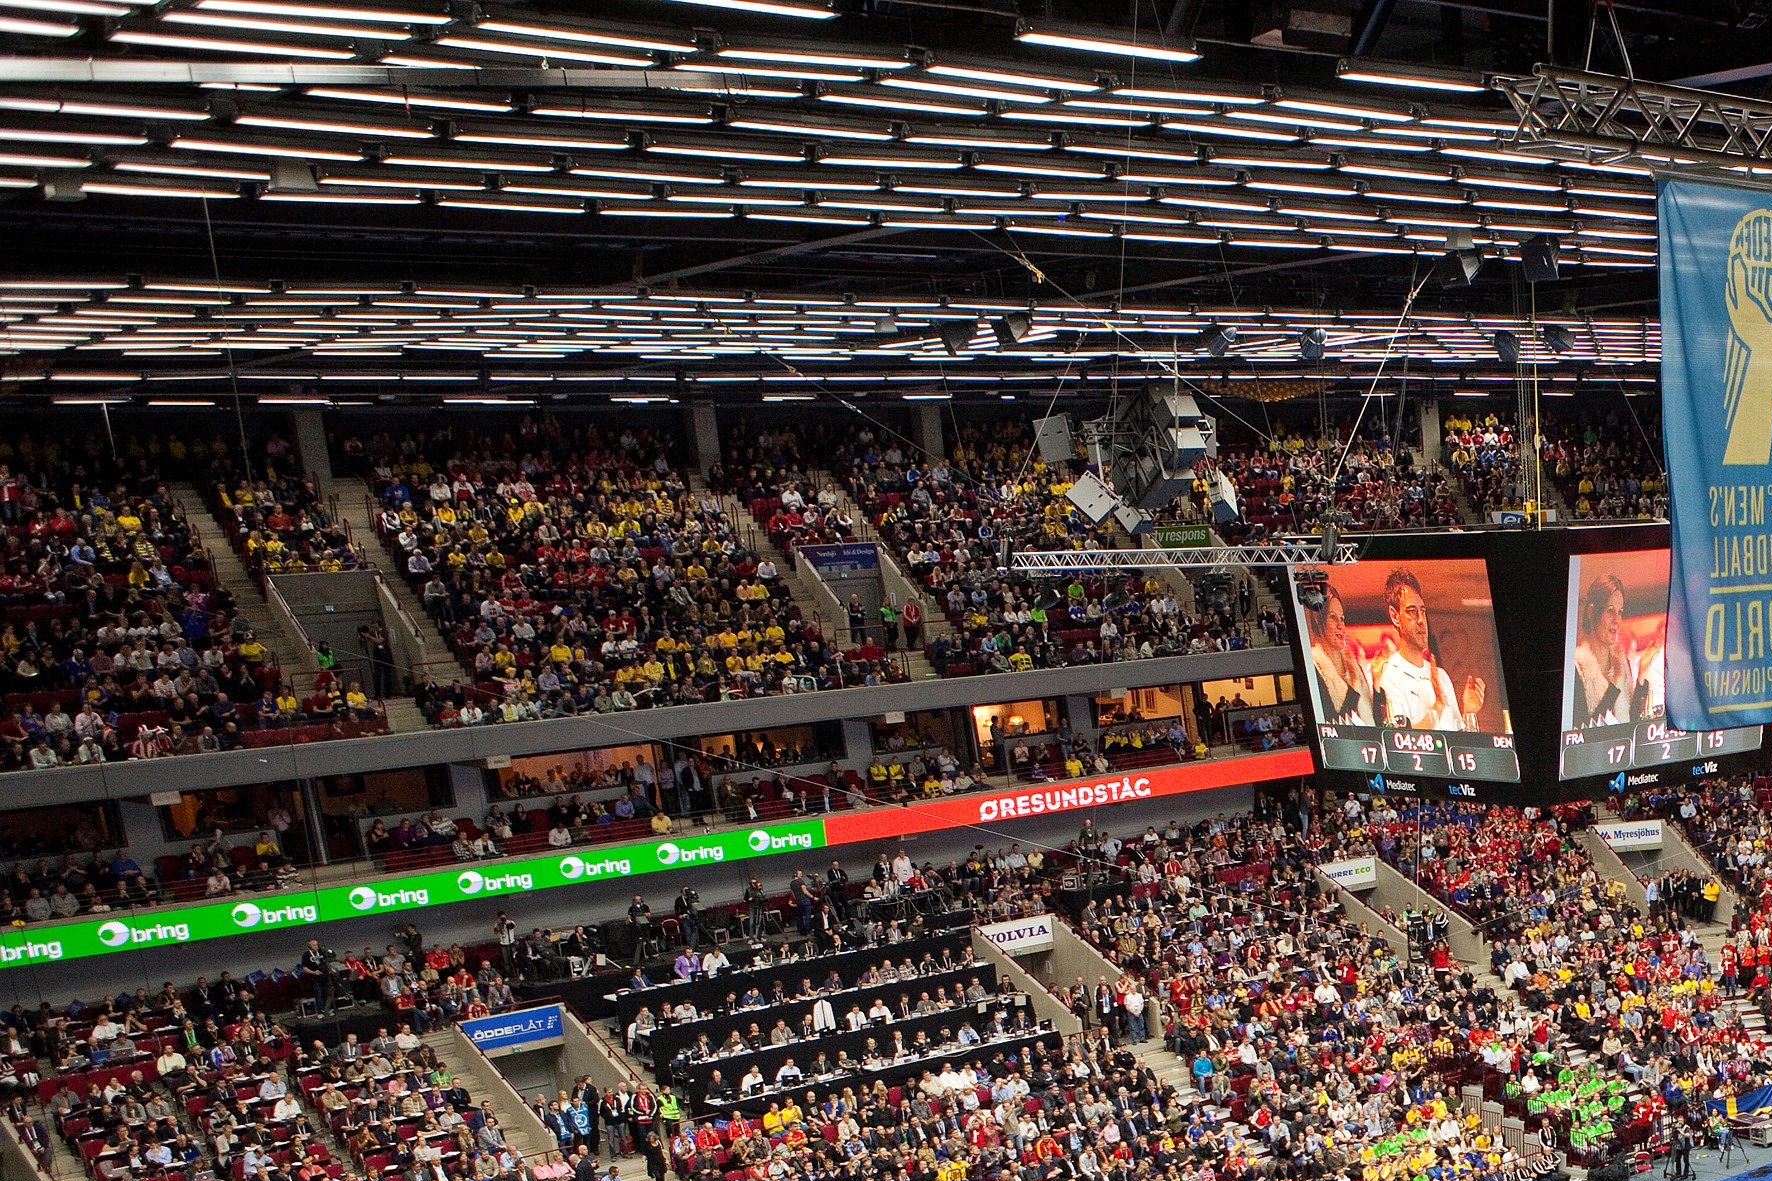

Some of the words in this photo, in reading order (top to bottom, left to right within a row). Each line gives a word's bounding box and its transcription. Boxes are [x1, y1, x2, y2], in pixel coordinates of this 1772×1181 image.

[1166, 529, 1206, 544] respons
[1321, 726, 1339, 738] FRA
[1394, 732, 1434, 751] 04:48
[1493, 736, 1513, 748] DEN
[1566, 732, 1585, 746] FRA
[1607, 744, 1625, 764] 17
[1661, 743, 1671, 760] 2
[1707, 731, 1724, 748] 15
[1361, 747, 1377, 764] 17
[1412, 755, 1423, 771] 2
[1458, 753, 1476, 771] 15
[1692, 761, 1718, 776] tecViz
[1386, 779, 1417, 792] Mediatec
[1449, 783, 1476, 797] tecViz
[1627, 772, 1659, 786] Mediatec
[980, 777, 1152, 821] ØRESUNDSTÅG
[771, 831, 812, 850] bring
[1613, 827, 1660, 841] Myresjöhus
[681, 843, 725, 864] bring
[585, 856, 631, 876] bring
[1355, 866, 1371, 875] ECO
[484, 871, 533, 892] bring
[378, 885, 428, 906] bring
[262, 903, 317, 925] bring
[131, 921, 190, 944] bring
[1, 940, 63, 963] bring
